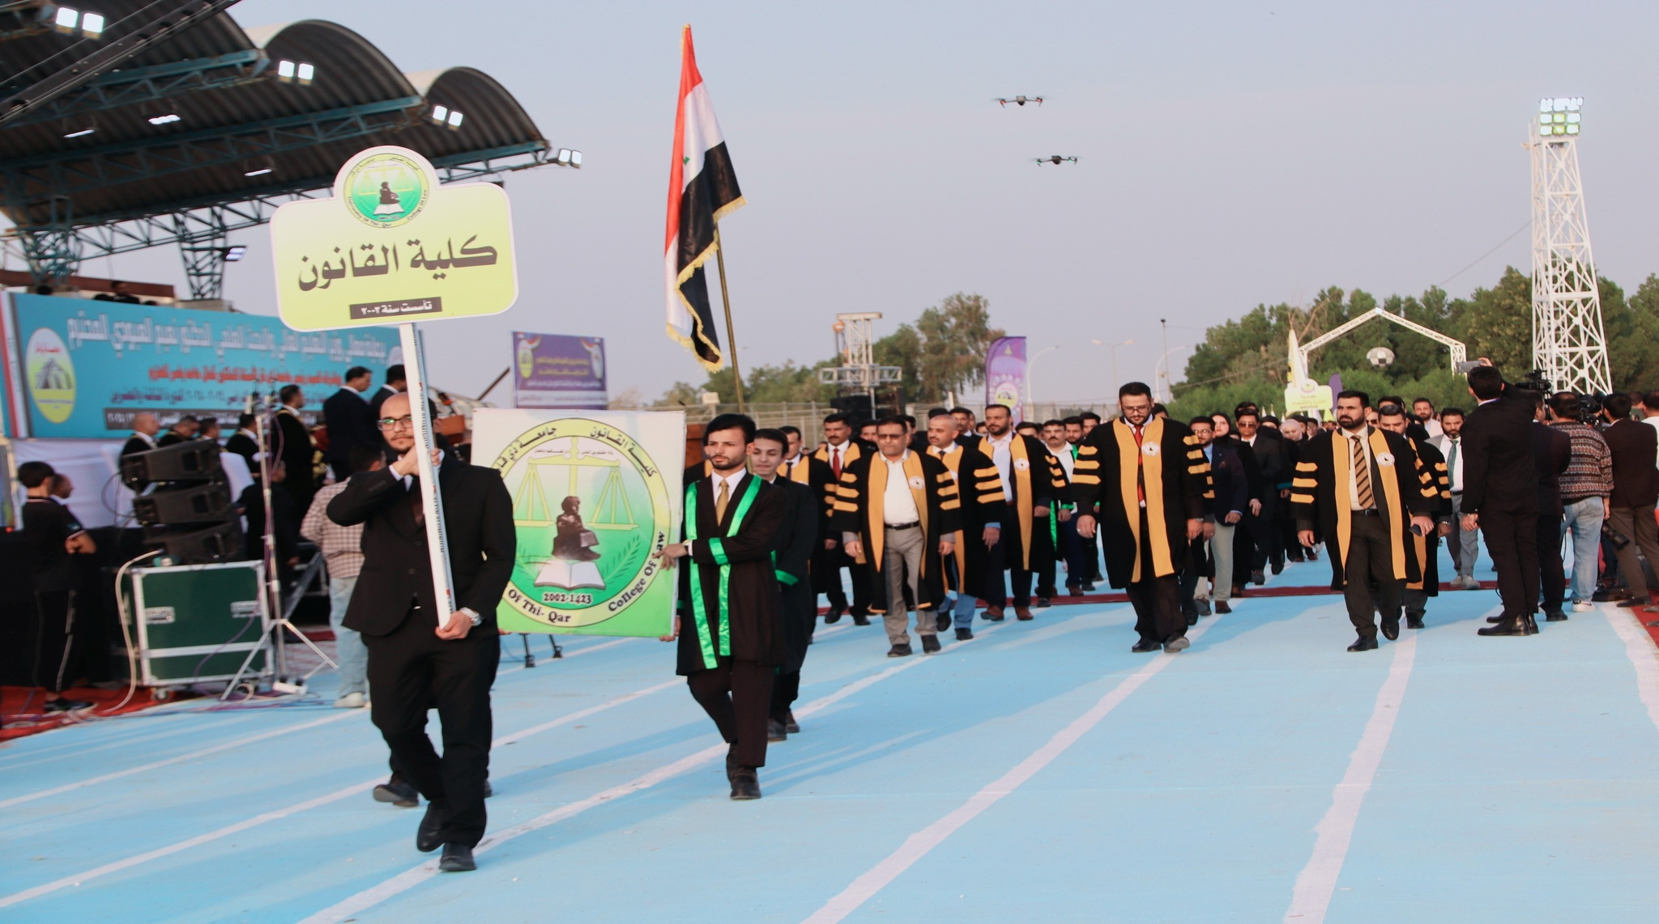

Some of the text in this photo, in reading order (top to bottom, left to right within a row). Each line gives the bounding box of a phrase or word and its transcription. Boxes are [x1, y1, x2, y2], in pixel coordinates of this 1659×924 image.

[298, 234, 498, 291] كلية القانون
[381, 304, 400, 314] سنة
[400, 300, 432, 312] تأسست
[67, 309, 108, 350] المحترم
[515, 427, 557, 448] جامعة
[590, 426, 658, 477] كلية القانون
[544, 592, 592, 604] 2002-1423
[608, 579, 646, 612] College
[644, 560, 657, 576] Of
[508, 589, 522, 603] Of
[548, 610, 571, 623] Qar
